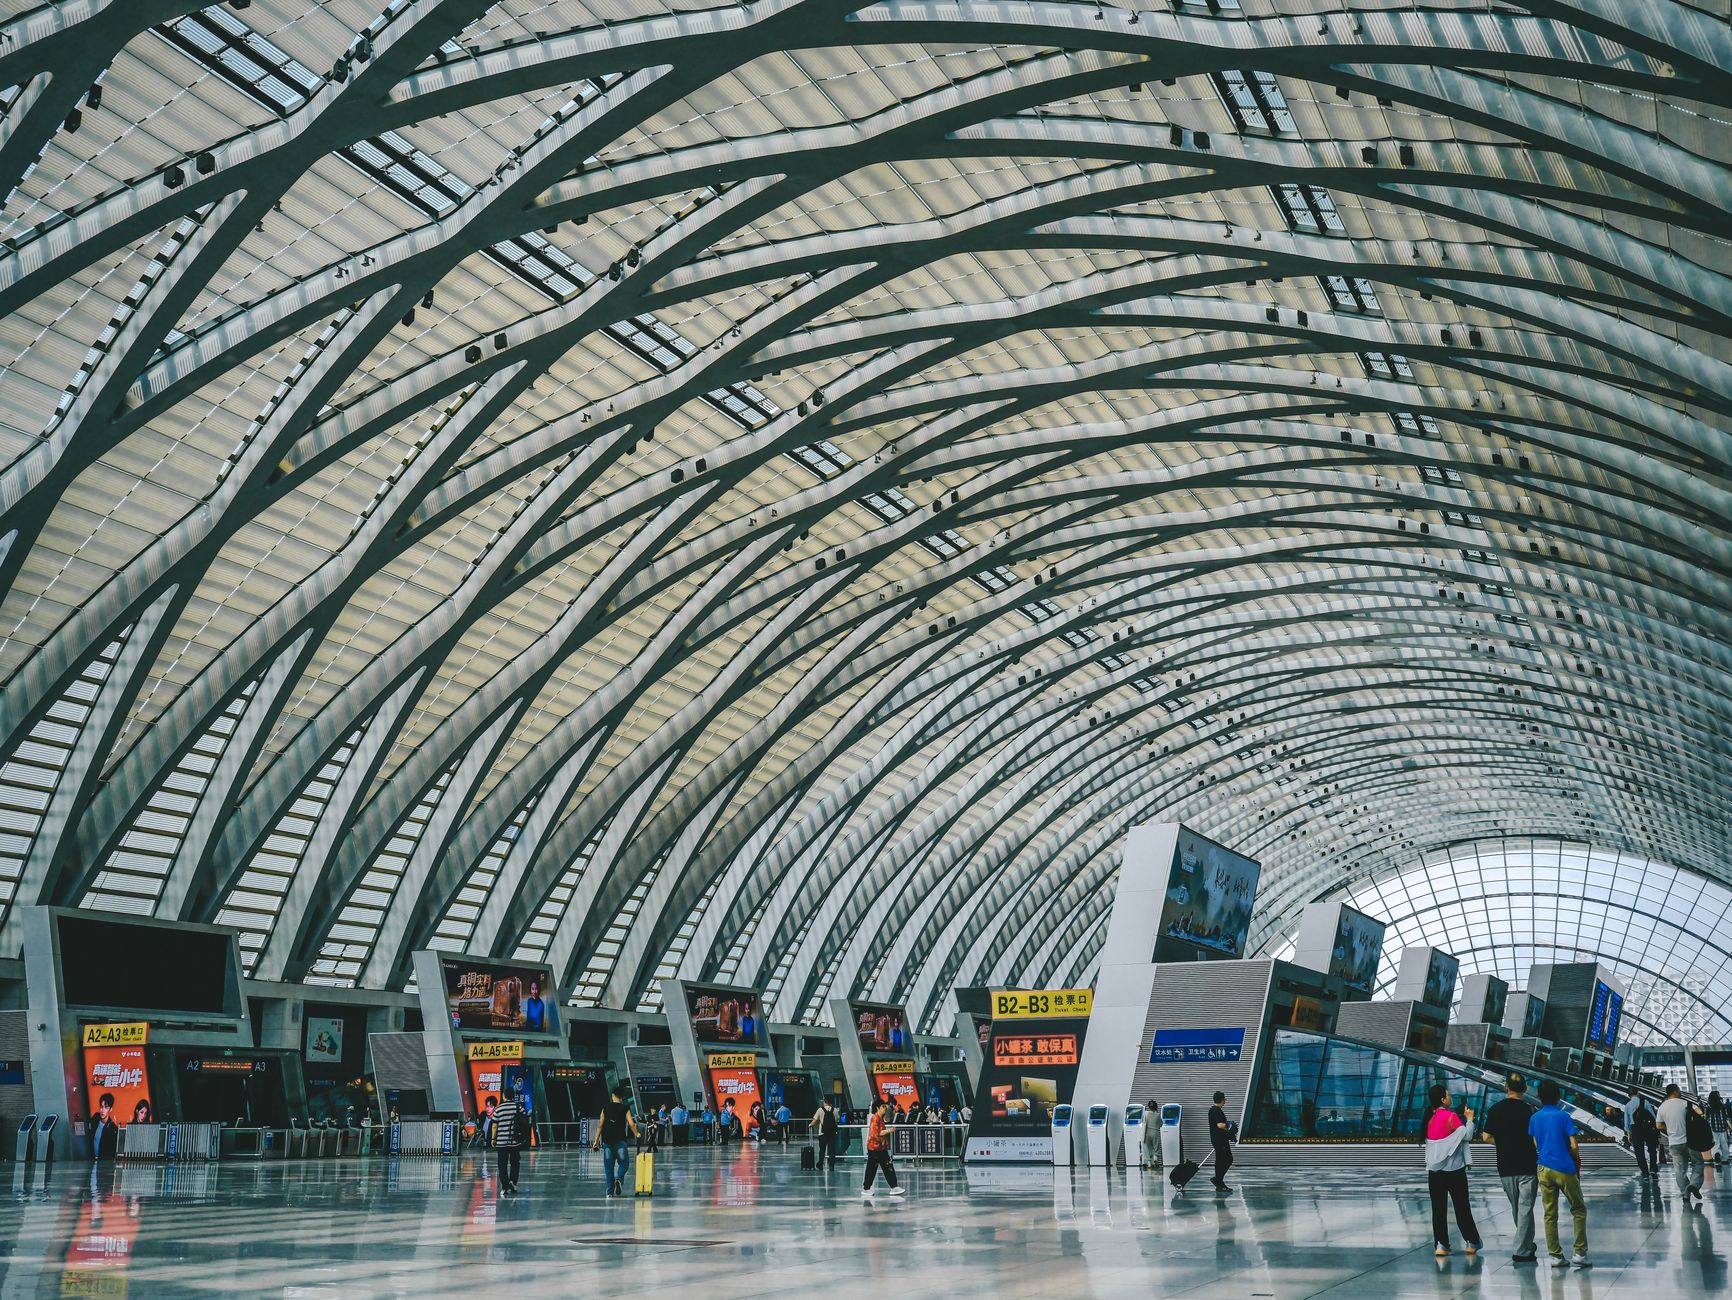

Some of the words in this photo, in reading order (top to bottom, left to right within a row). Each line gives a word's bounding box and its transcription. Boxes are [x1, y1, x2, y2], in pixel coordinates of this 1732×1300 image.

[998, 996, 1049, 1014] B2-B3
[1054, 995, 1087, 1006] 检票口
[87, 1028, 121, 1043] A2-A3
[123, 1028, 144, 1036] 检票口
[472, 1045, 500, 1057] A4-A5
[997, 1039, 1033, 1055] 小罐茶
[1037, 1038, 1074, 1054] 敢保真
[187, 1060, 199, 1071] A2
[255, 1061, 266, 1072] A3
[711, 1056, 736, 1066] A6-A7
[875, 1063, 898, 1072] A8-A9
[119, 1068, 143, 1087] 小牛
[588, 1071, 596, 1079] A5
[737, 1082, 755, 1094] 小牛
